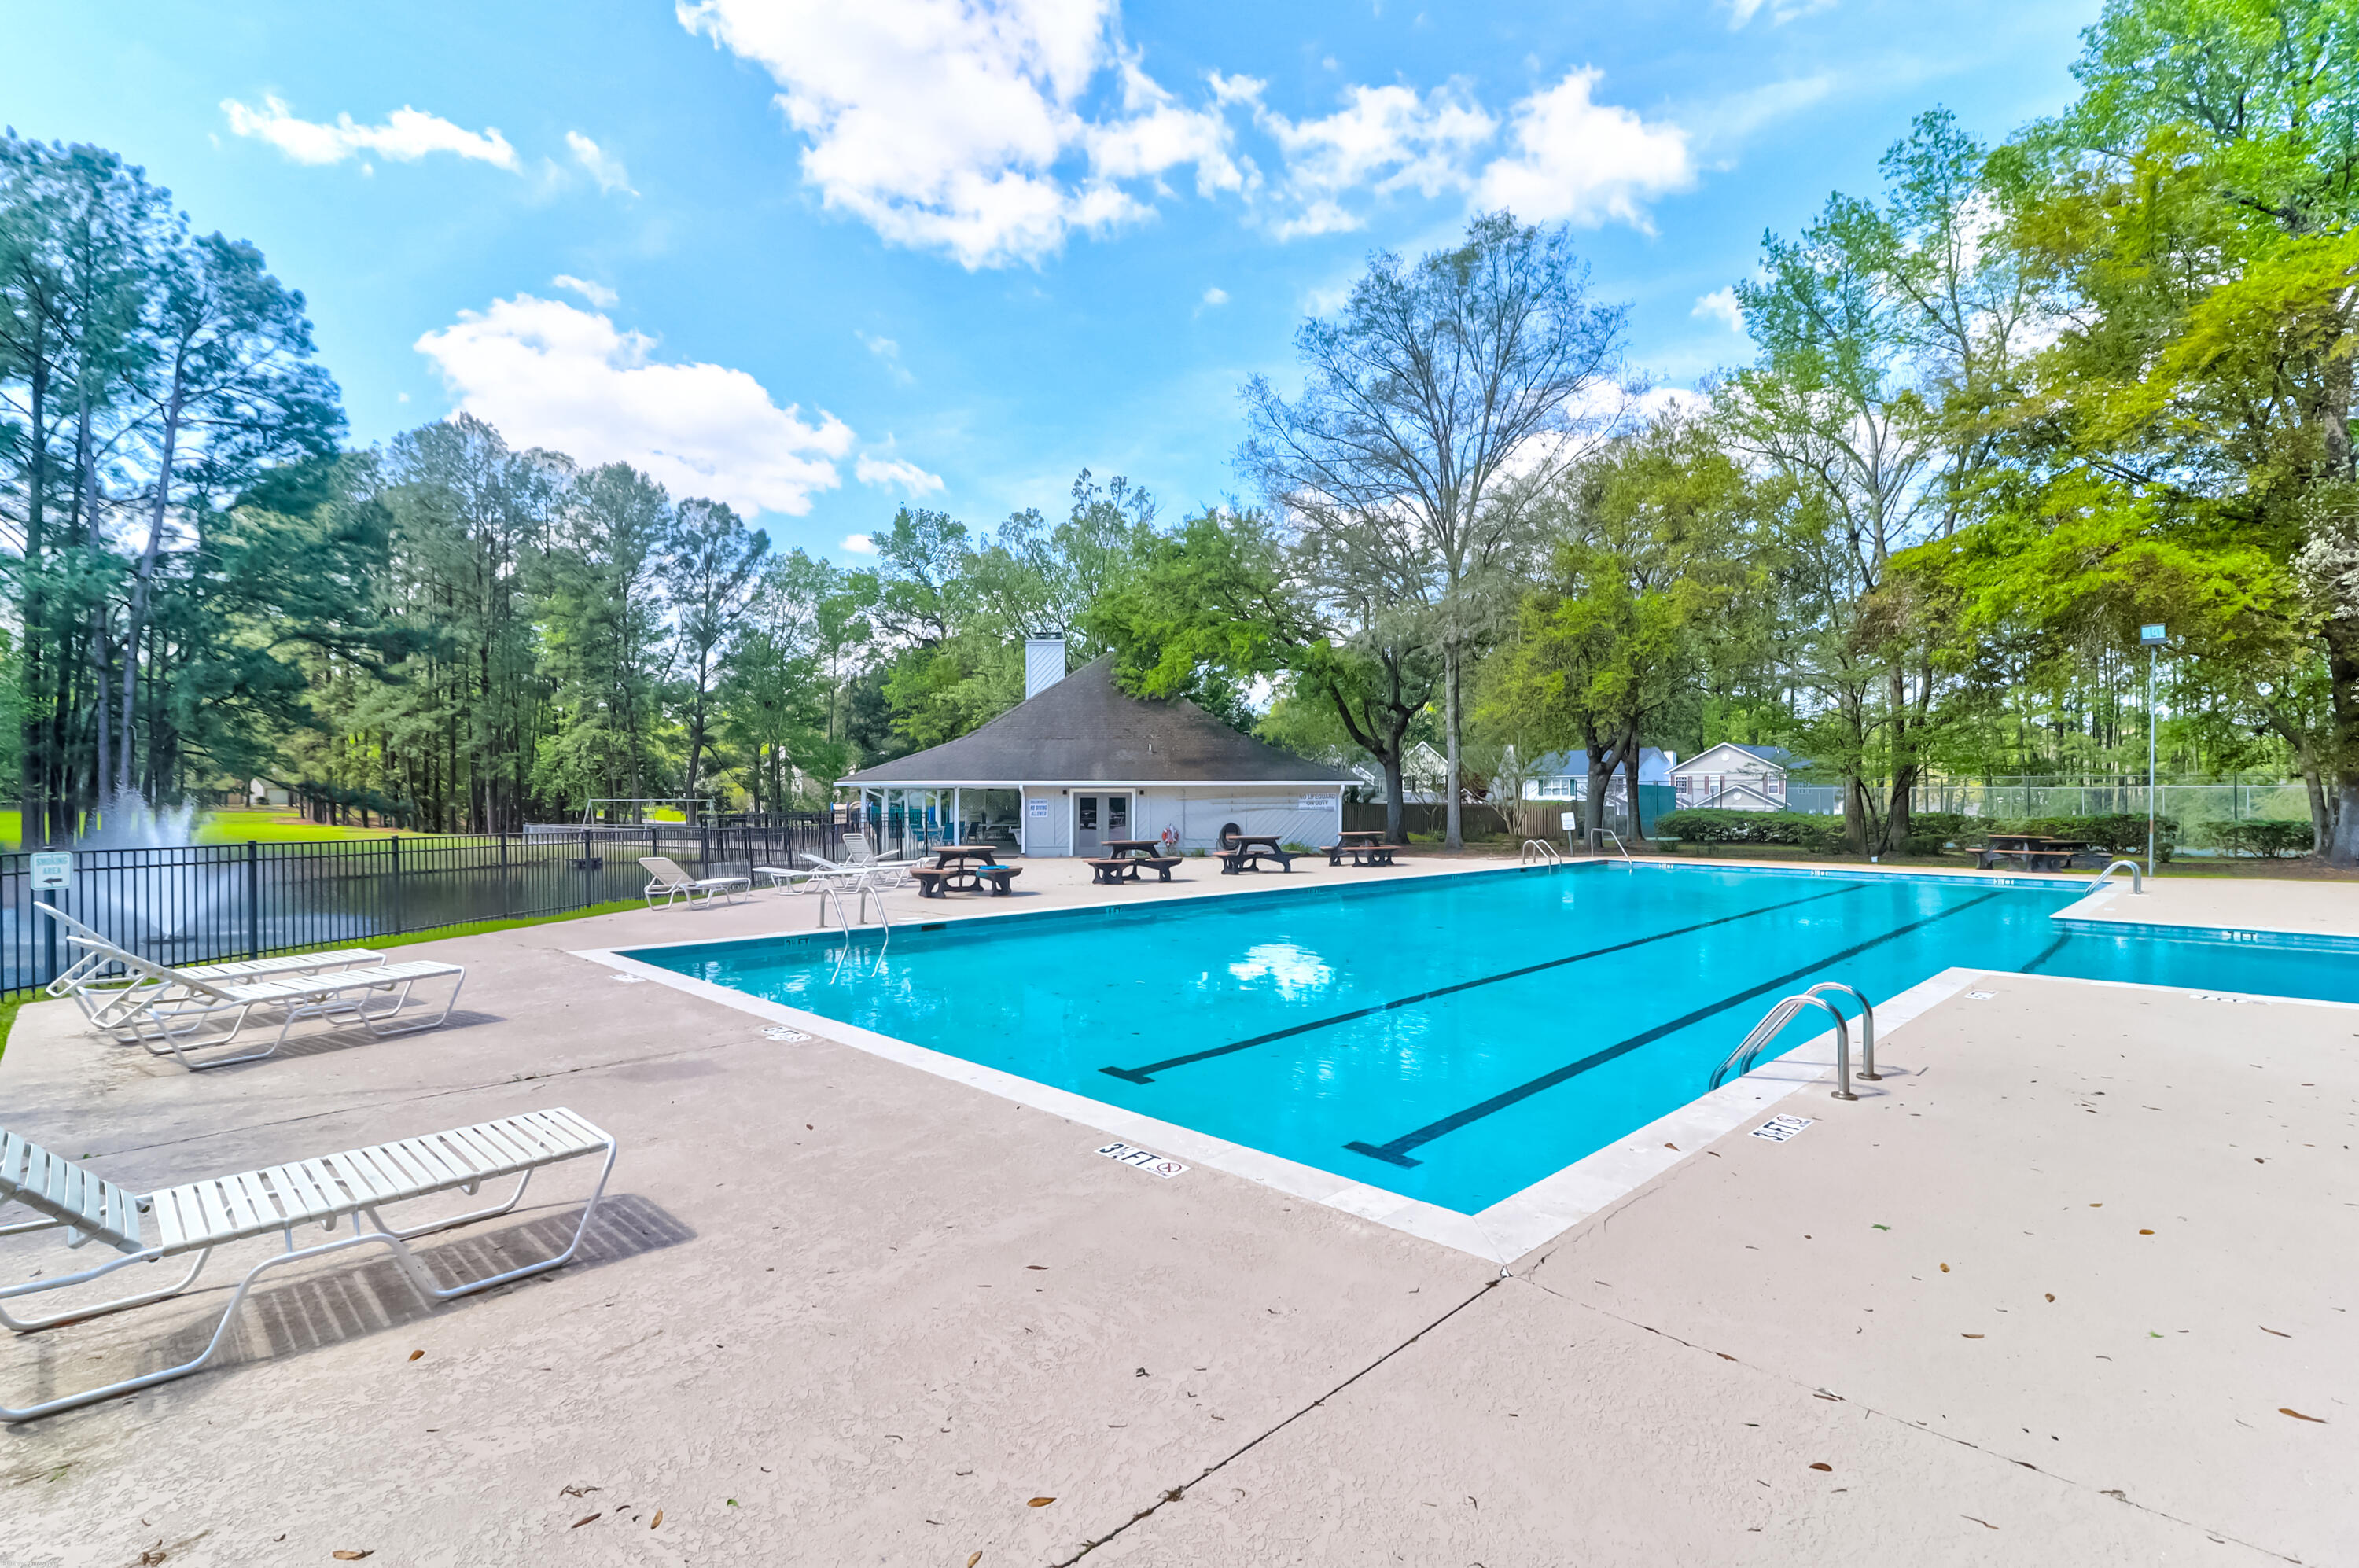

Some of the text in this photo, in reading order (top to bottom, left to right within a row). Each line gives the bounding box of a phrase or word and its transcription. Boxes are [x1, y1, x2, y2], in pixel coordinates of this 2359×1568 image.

[36, 856, 68, 866] SMOKING
[1763, 1121, 1799, 1134] FT
[1121, 1151, 1162, 1165] FT
